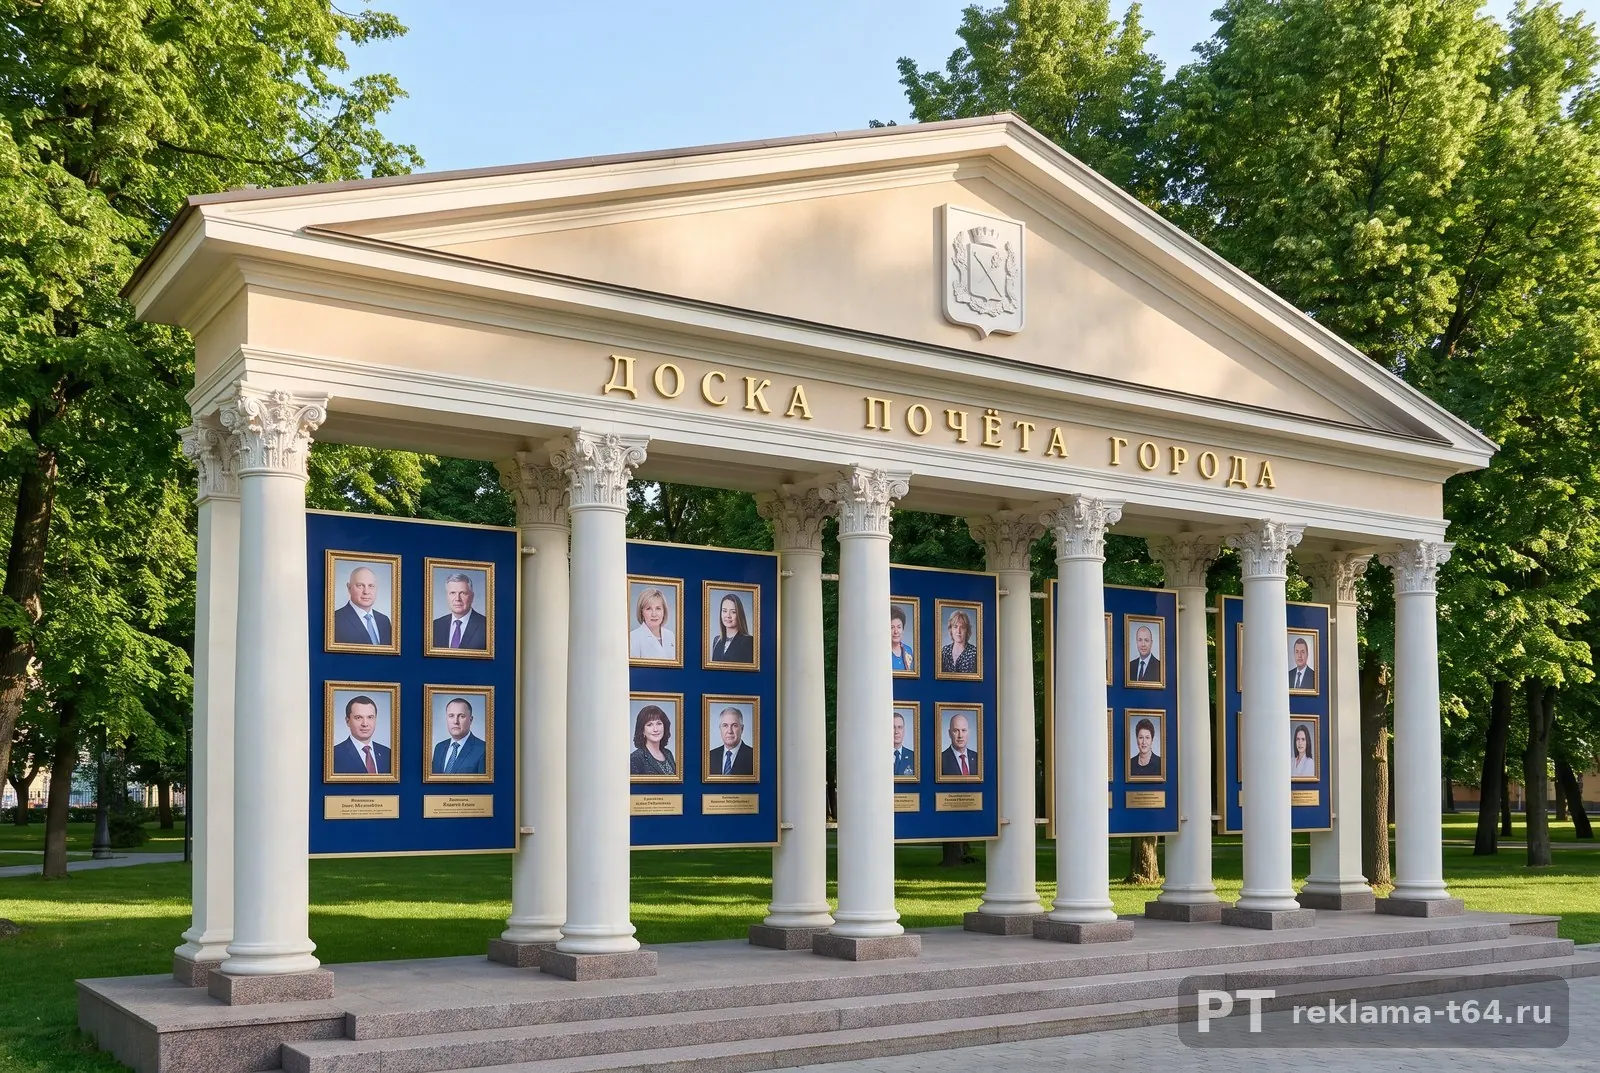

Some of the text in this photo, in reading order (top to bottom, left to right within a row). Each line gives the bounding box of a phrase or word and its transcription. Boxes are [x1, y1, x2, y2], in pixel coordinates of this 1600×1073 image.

[603, 354, 1277, 489] ДОСКА ПОЧЁТА ГОРОДА
